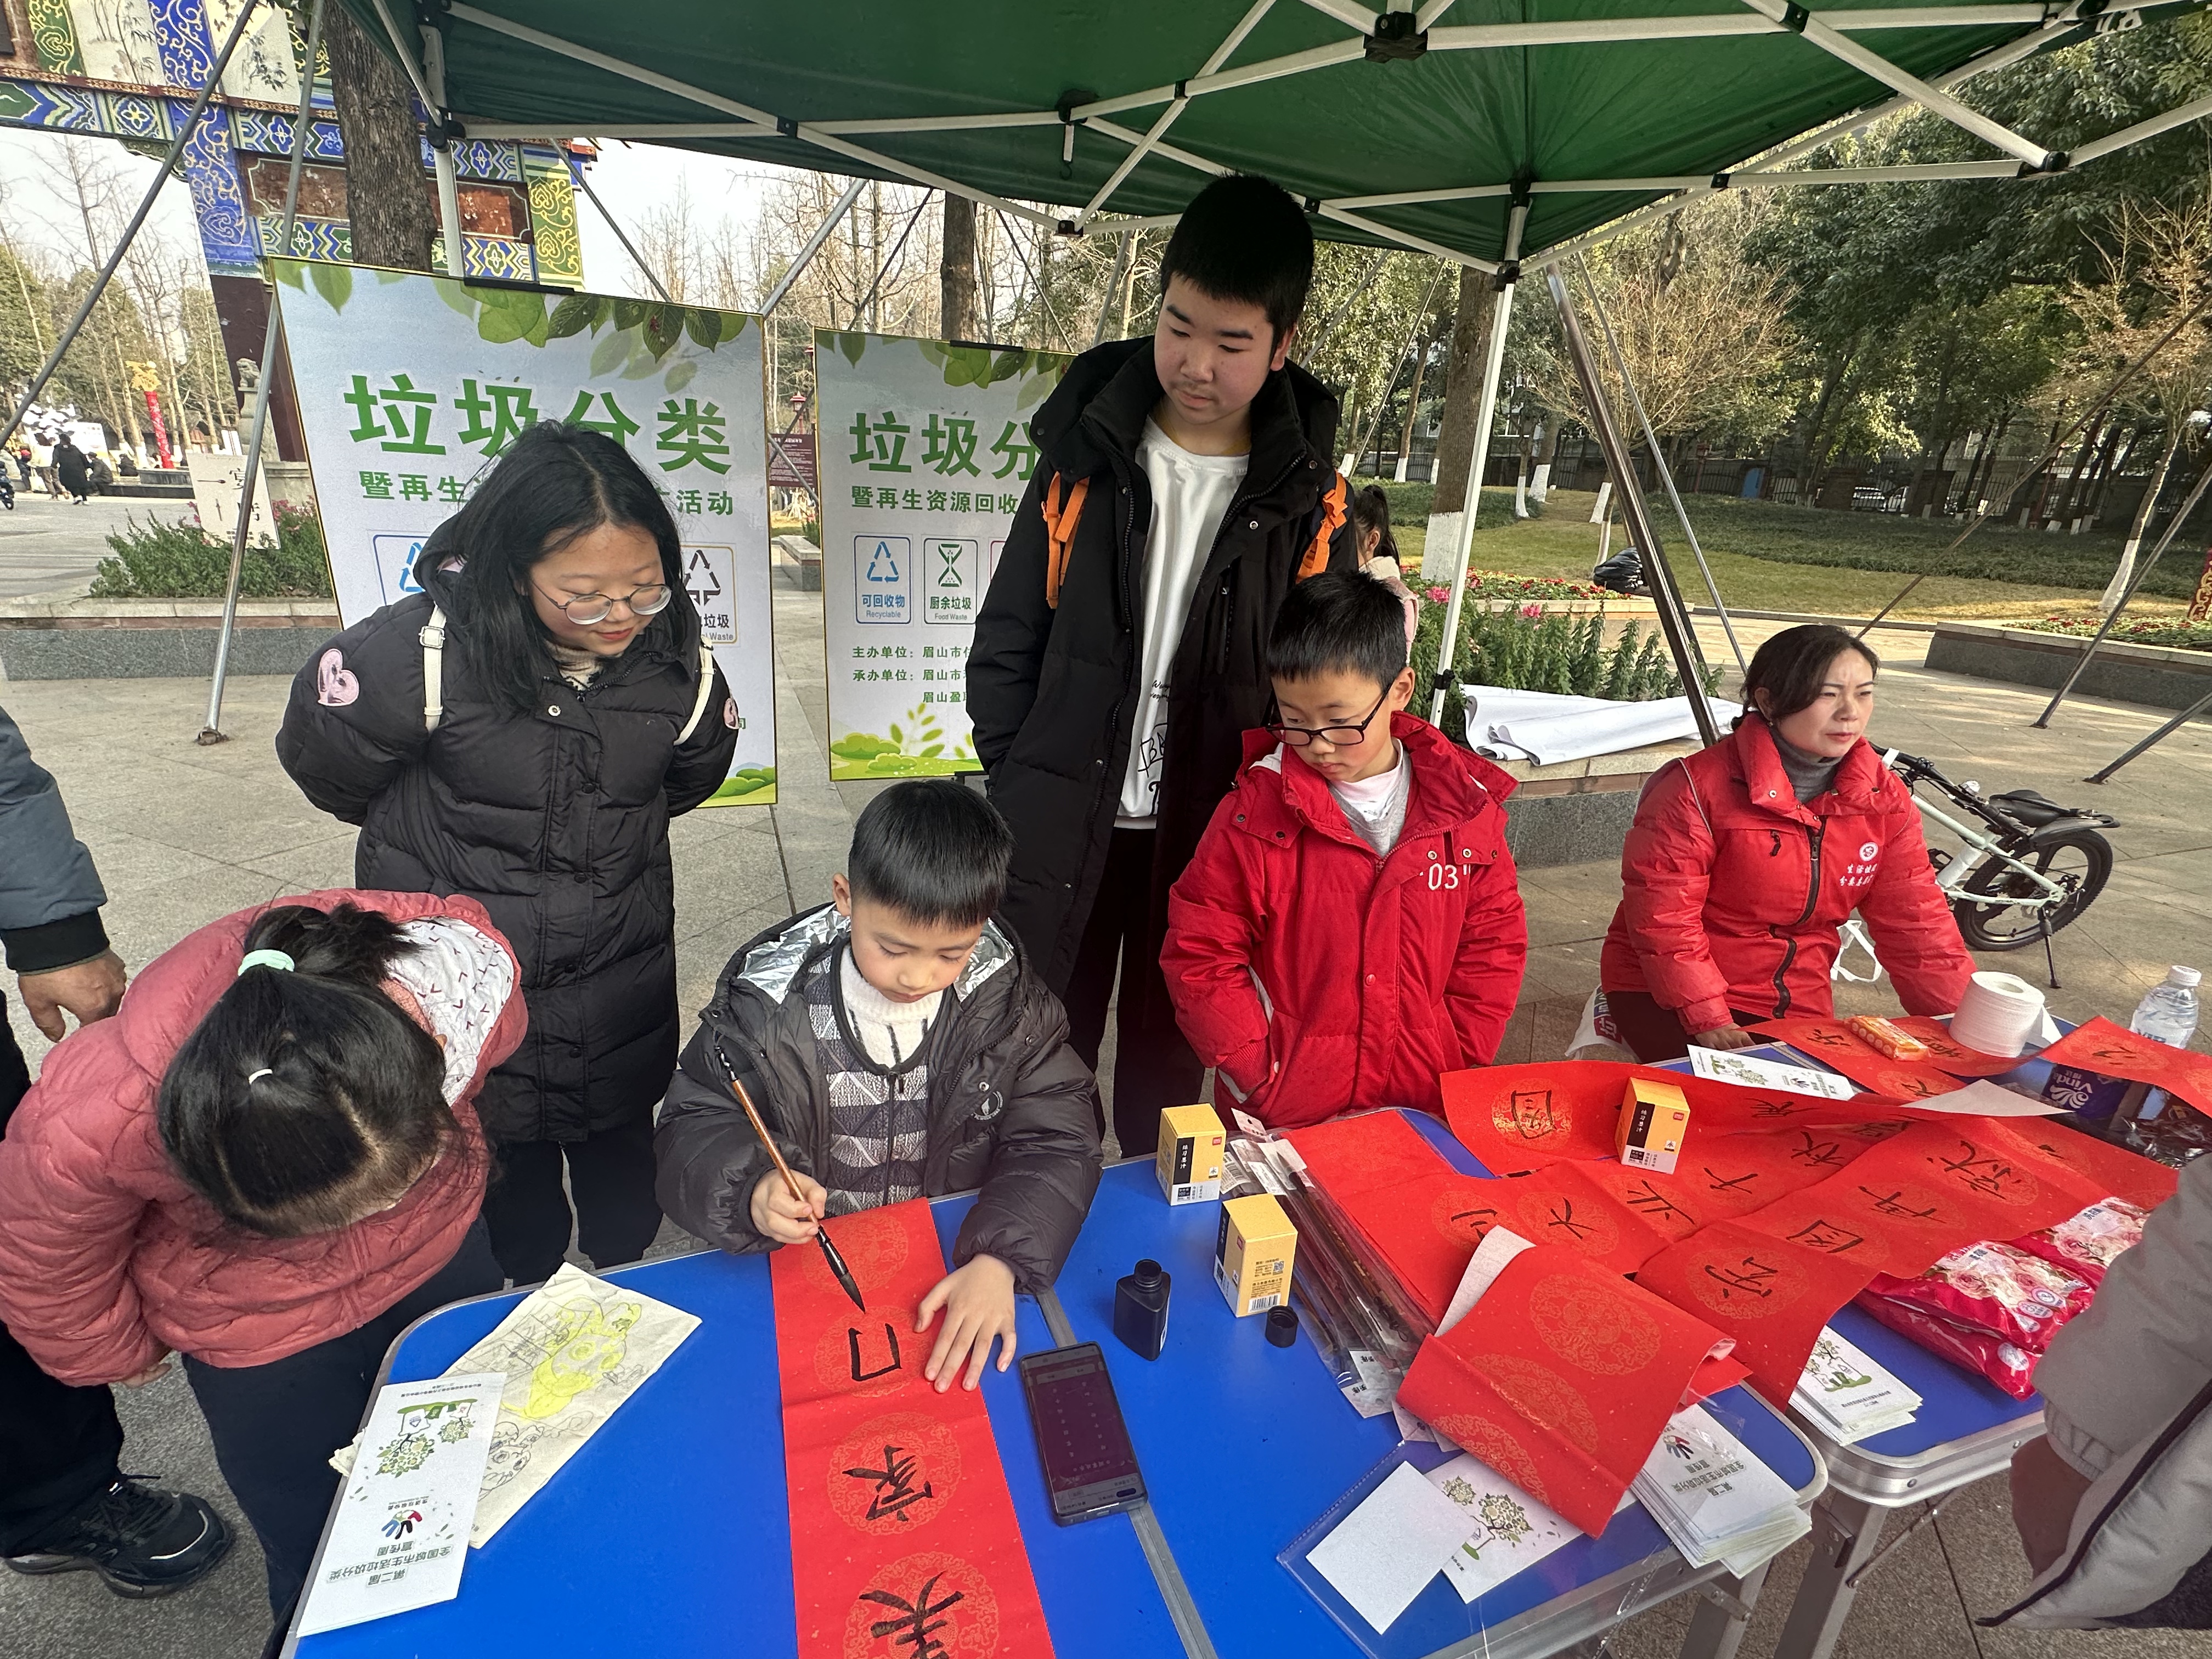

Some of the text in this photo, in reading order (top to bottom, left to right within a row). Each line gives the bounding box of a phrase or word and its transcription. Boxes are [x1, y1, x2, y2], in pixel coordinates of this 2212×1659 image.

[851, 486, 1018, 516] 暨再生资源回收
[862, 594, 905, 608] 可回收物
[930, 596, 972, 610] 厨余垃圾
[700, 614, 730, 629] 垃圾
[709, 633, 734, 641] Waste
[923, 669, 966, 681] 眉山市
[329, 1546, 452, 1581] 全国城市生活垃圾分类
